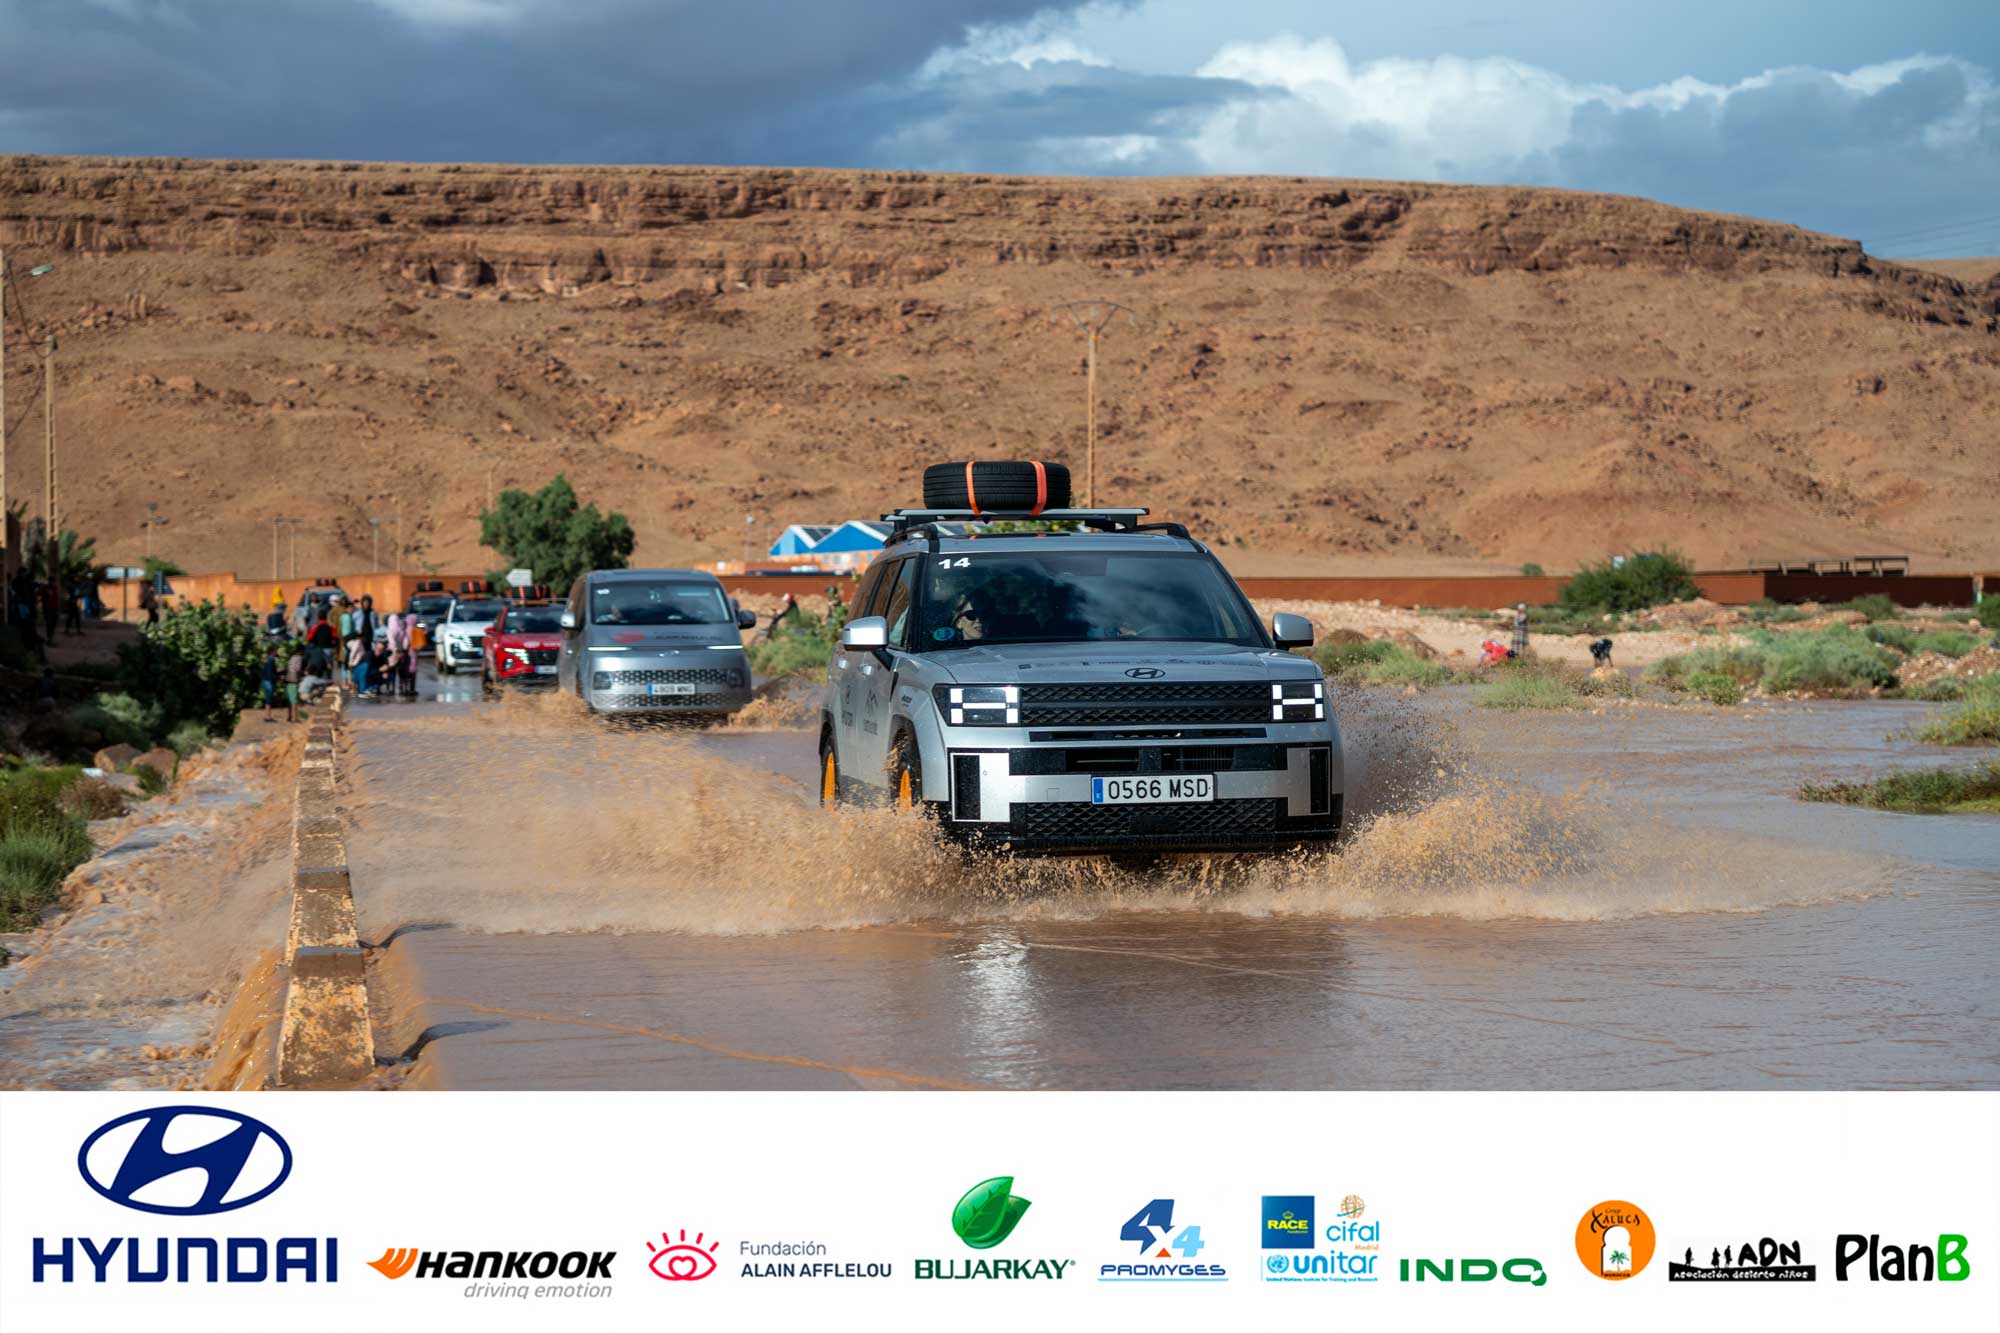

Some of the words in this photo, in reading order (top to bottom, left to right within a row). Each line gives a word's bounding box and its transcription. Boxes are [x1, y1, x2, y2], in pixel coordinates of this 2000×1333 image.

[938, 557, 971, 570] 14
[1108, 779, 1161, 800] 0566
[1169, 778, 1208, 798] MSD
